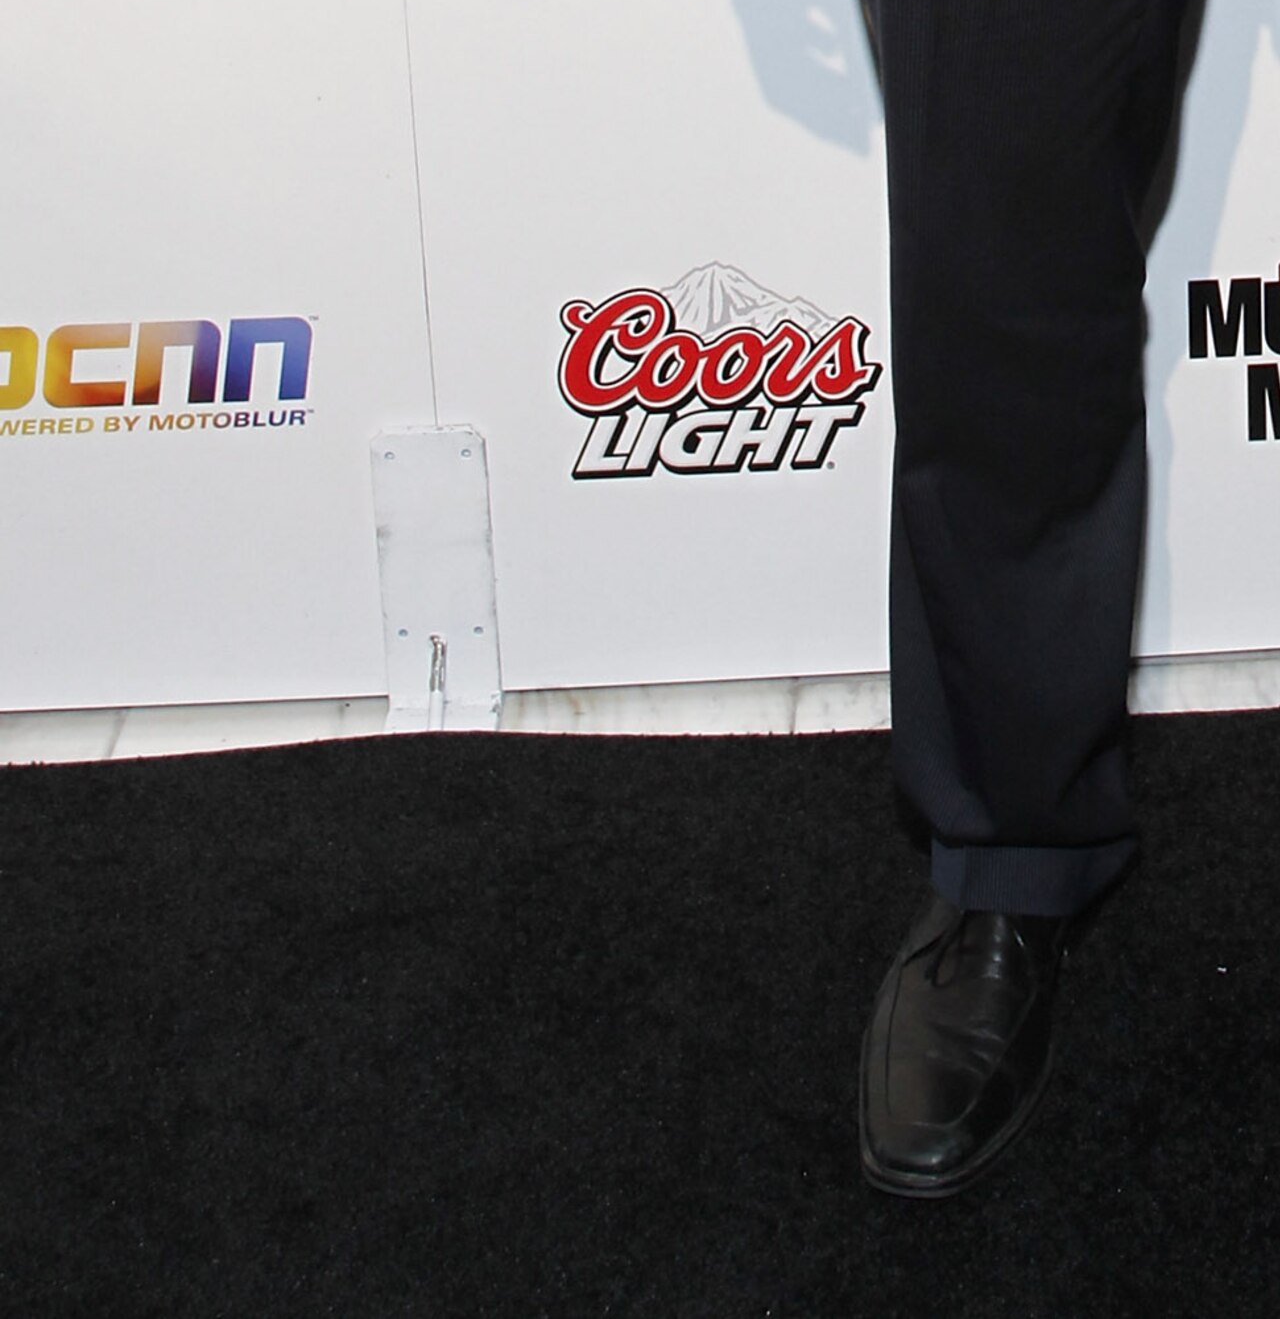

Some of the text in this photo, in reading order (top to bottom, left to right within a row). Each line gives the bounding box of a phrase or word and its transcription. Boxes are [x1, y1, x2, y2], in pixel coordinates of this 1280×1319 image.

[558, 288, 883, 417] Coors
[104, 415, 140, 432] BY
[149, 410, 307, 431] MOTOBLUR
[572, 402, 866, 480] LIGHT
